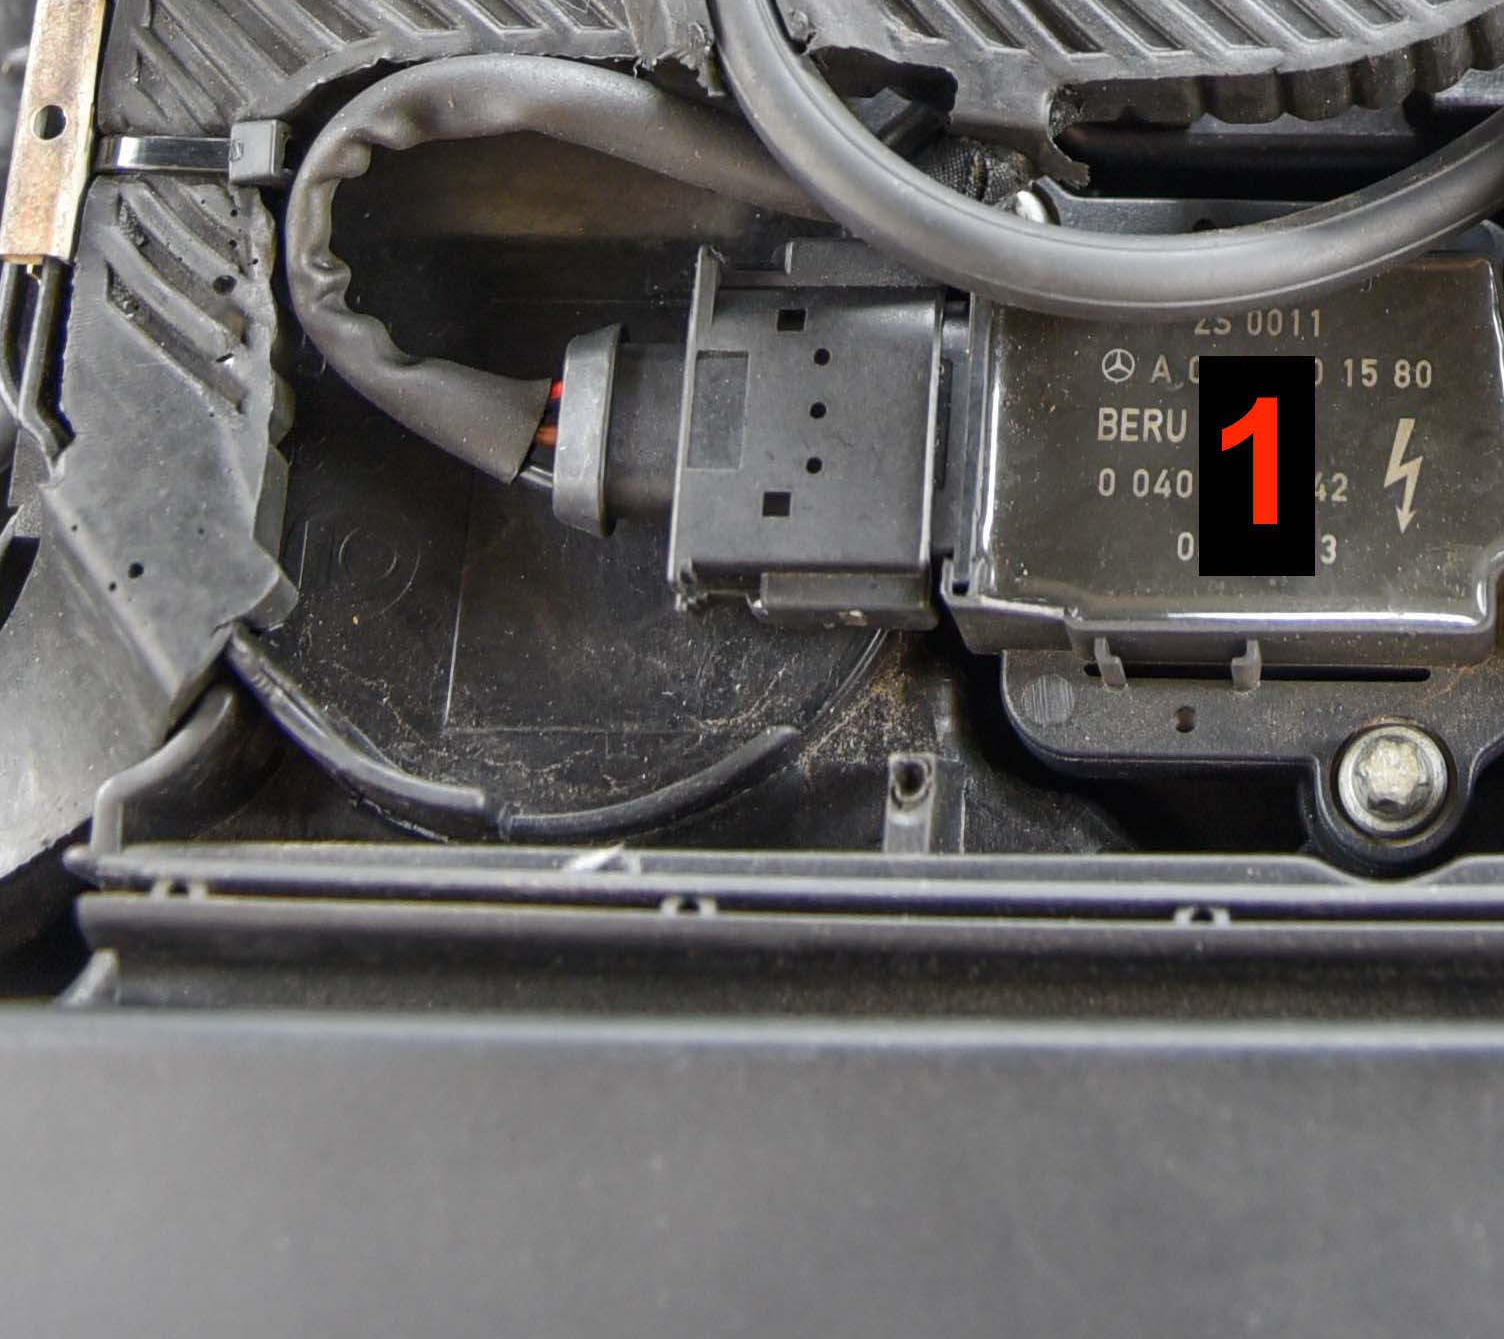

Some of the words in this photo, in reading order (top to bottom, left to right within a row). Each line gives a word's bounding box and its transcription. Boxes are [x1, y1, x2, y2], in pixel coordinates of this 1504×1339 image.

[1246, 308, 1321, 338] 0011
[1150, 354, 1173, 384] A
[1343, 359, 1379, 388] 15
[1393, 359, 1433, 389] 80
[1097, 406, 1188, 444] BERU
[1097, 468, 1116, 497] 0
[1133, 468, 1194, 498] 040
